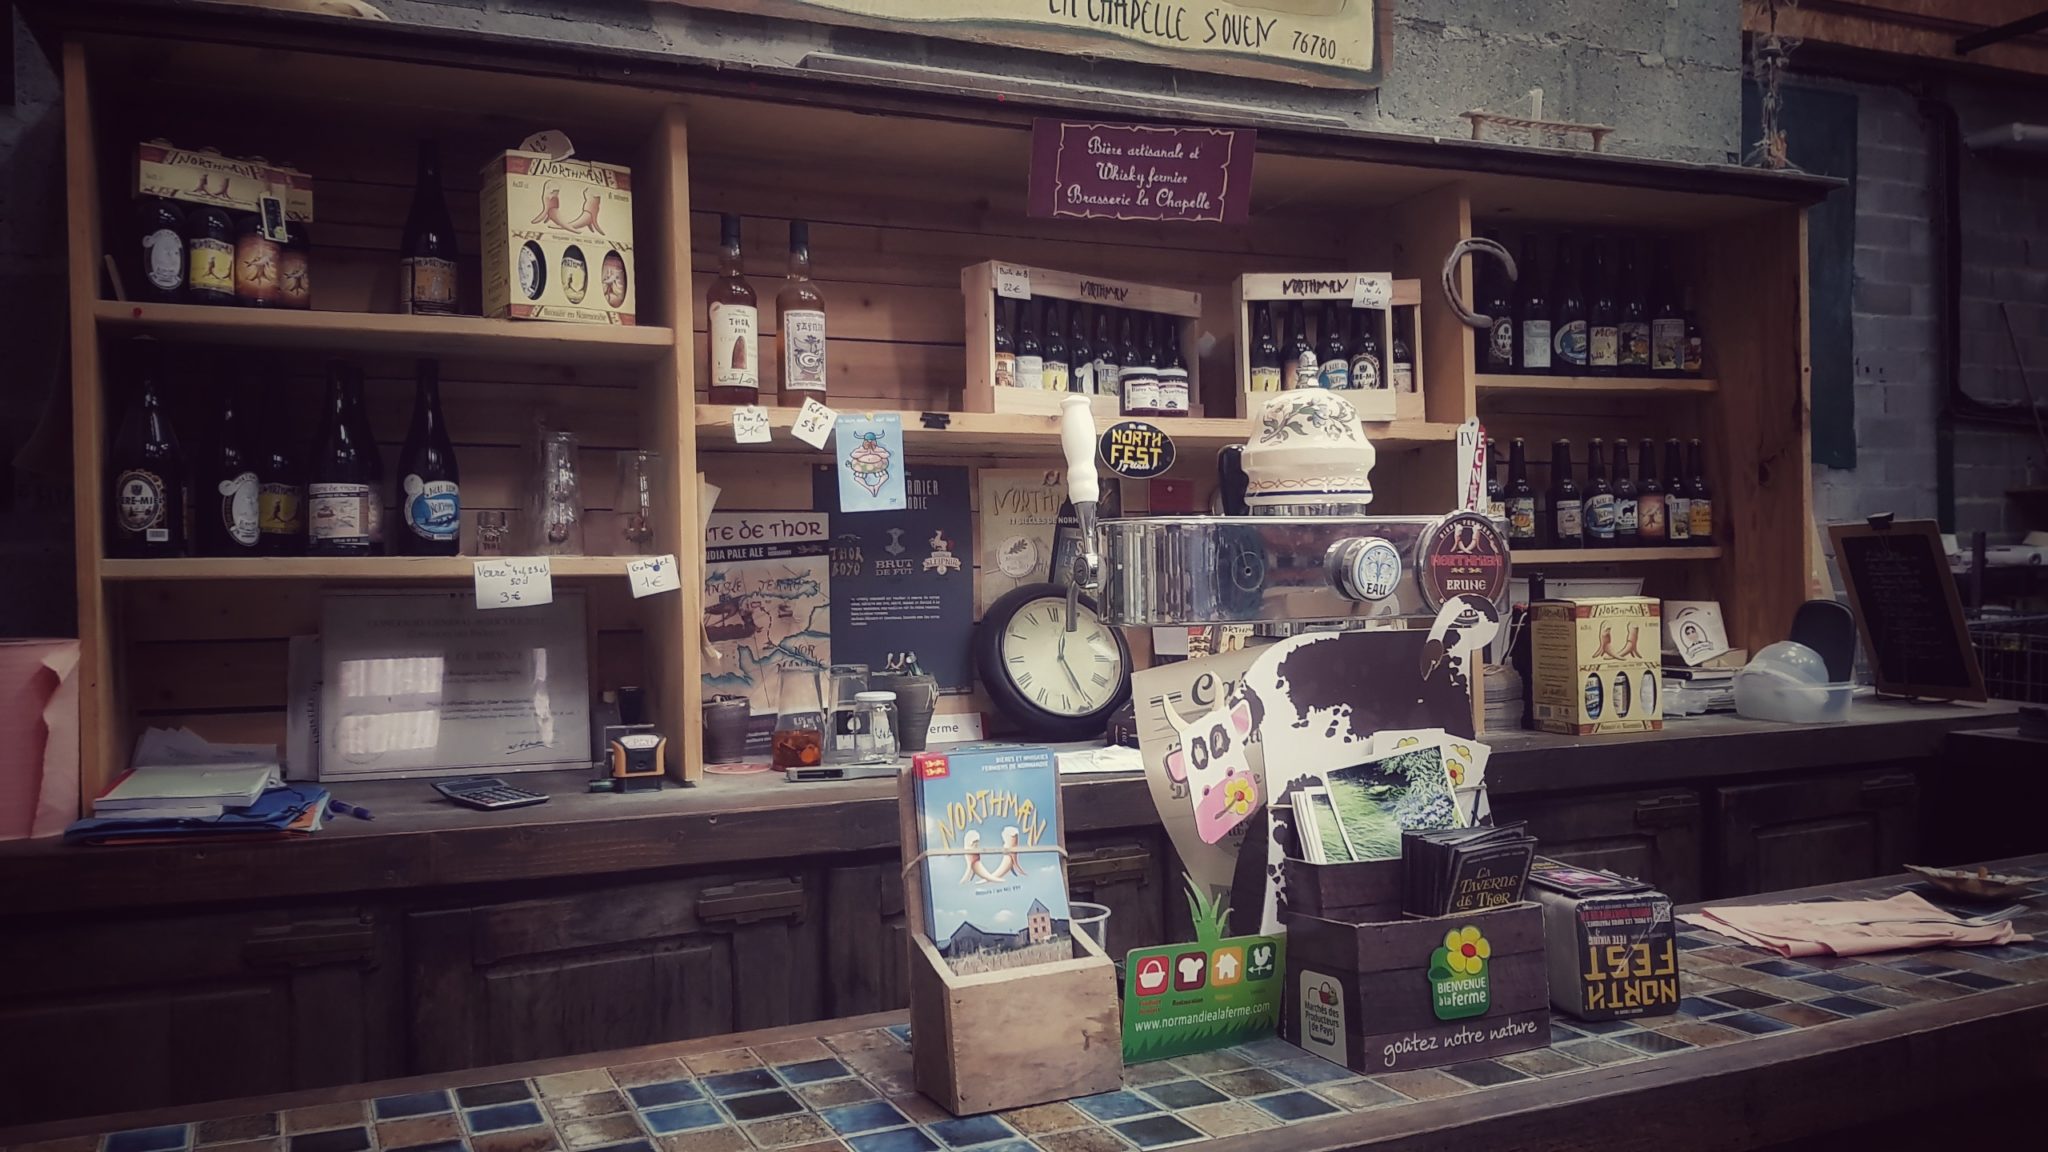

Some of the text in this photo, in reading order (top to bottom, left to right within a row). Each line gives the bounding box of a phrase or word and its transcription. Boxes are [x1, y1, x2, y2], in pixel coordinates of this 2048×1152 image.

[1088, 0, 1189, 41] CHAPELLE
[1291, 30, 1337, 60] 76780
[1087, 136, 1201, 160] Bière artisanale et
[1096, 162, 1188, 189] Whisky fermier
[1067, 184, 1212, 215] Brasserie la Chapelle
[1110, 444, 1163, 465] FEST
[727, 548, 748, 559] PALE
[749, 546, 765, 558] ALE
[875, 559, 913, 569] BRUT
[875, 568, 889, 577] DE
[1366, 582, 1387, 596] EAU
[1446, 579, 1487, 591] BRUNE
[1476, 867, 1492, 878] LA
[1459, 875, 1518, 894] TAVERNE
[1583, 938, 1675, 981] FEST
[1437, 976, 1487, 994] BIENVENUE
[1452, 990, 1487, 1007] ferme
[1134, 1001, 1271, 1033] www.normandiealaferme.com
[1304, 1001, 1340, 1018] Marchés des
[1304, 1010, 1340, 1029] Producteurs
[1311, 1022, 1334, 1037] de Pays
[1383, 1016, 1538, 1068] goûtez notre nature
